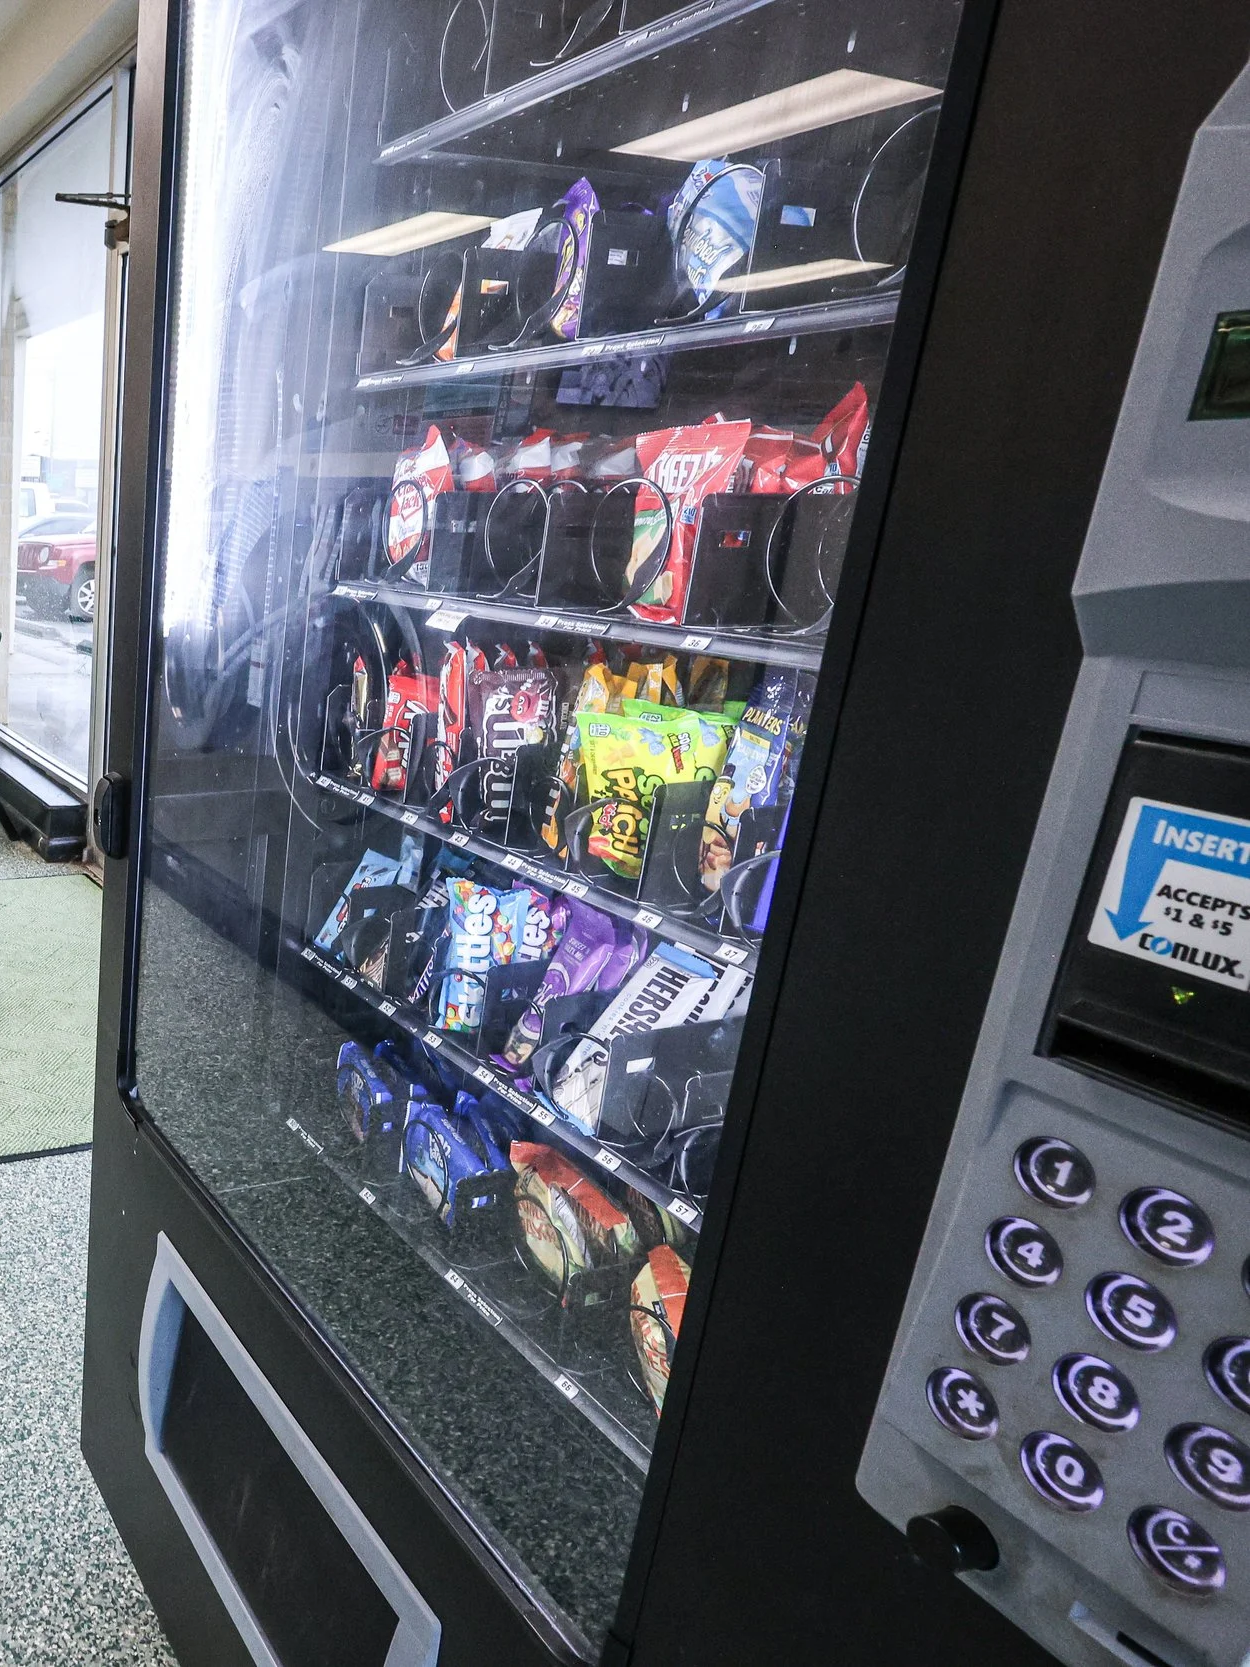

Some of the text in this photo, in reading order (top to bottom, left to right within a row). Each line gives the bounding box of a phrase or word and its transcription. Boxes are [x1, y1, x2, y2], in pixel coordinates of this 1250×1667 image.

[557, 618, 607, 631] Press Selection
[688, 639, 701, 648] 36
[1152, 819, 1250, 865] INSERT
[521, 862, 566, 883] Press Selection
[571, 884, 581, 893] 45
[1156, 884, 1250, 920] ACCEPTS
[642, 914, 652, 924] 46
[1163, 906, 1234, 936] $1 & $5
[723, 948, 738, 958] 47
[428, 1035, 437, 1044] 53
[478, 1070, 489, 1079] 54
[493, 1077, 534, 1108] Press Selection
[497, 1086, 522, 1106] For Price
[538, 1111, 549, 1120] 55
[601, 1153, 613, 1165] 56
[1051, 1160, 1074, 1188] 1
[675, 1203, 688, 1216] 57
[1156, 1210, 1195, 1246] 2
[1017, 1241, 1044, 1269] 4
[1123, 1294, 1157, 1329] 5
[990, 1312, 1016, 1340] 7
[561, 1381, 572, 1392] 66
[1087, 1376, 1120, 1410] 8
[1055, 1457, 1086, 1487] 0
[1207, 1450, 1243, 1485] 9
[1165, 1520, 1190, 1545] C
